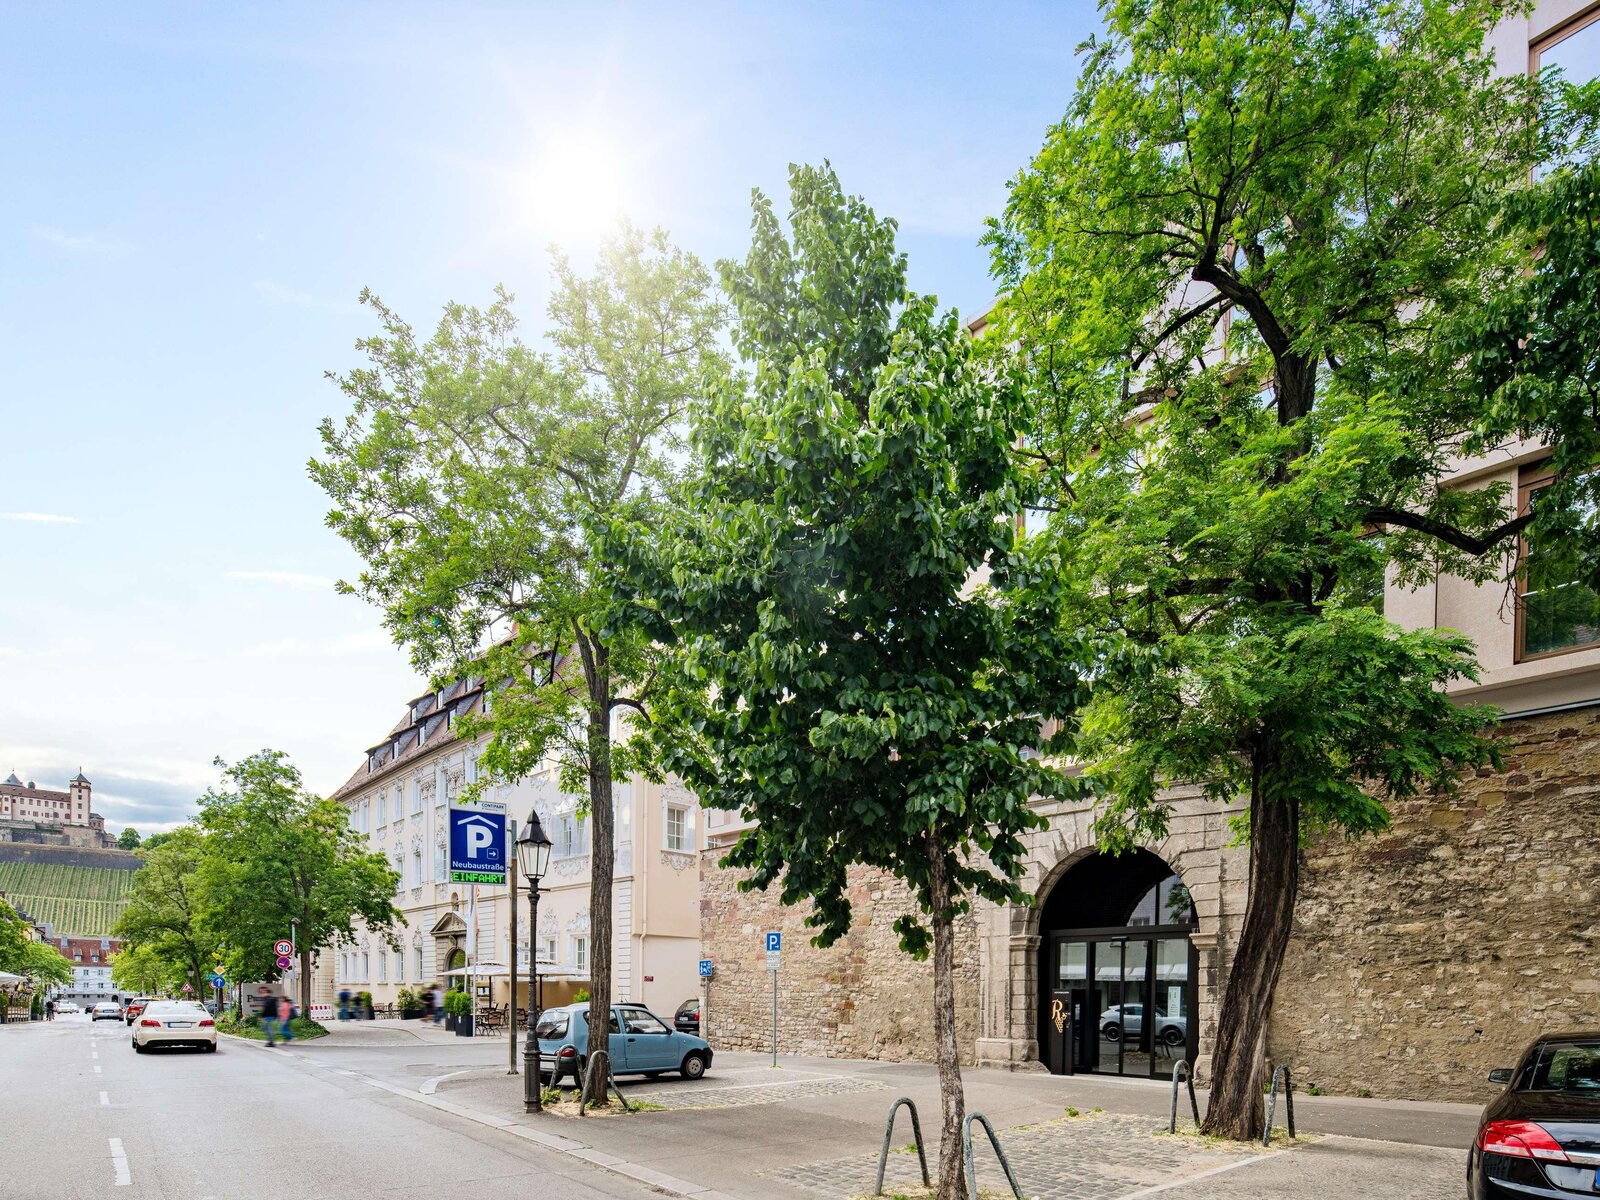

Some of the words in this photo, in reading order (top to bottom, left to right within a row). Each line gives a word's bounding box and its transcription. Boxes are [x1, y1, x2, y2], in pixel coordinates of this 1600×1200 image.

[467, 824, 493, 859] P
[452, 861, 505, 871] Neubaustraße
[453, 872, 504, 883] EINFAHRT
[769, 935, 778, 950] P
[278, 944, 290, 953] 30
